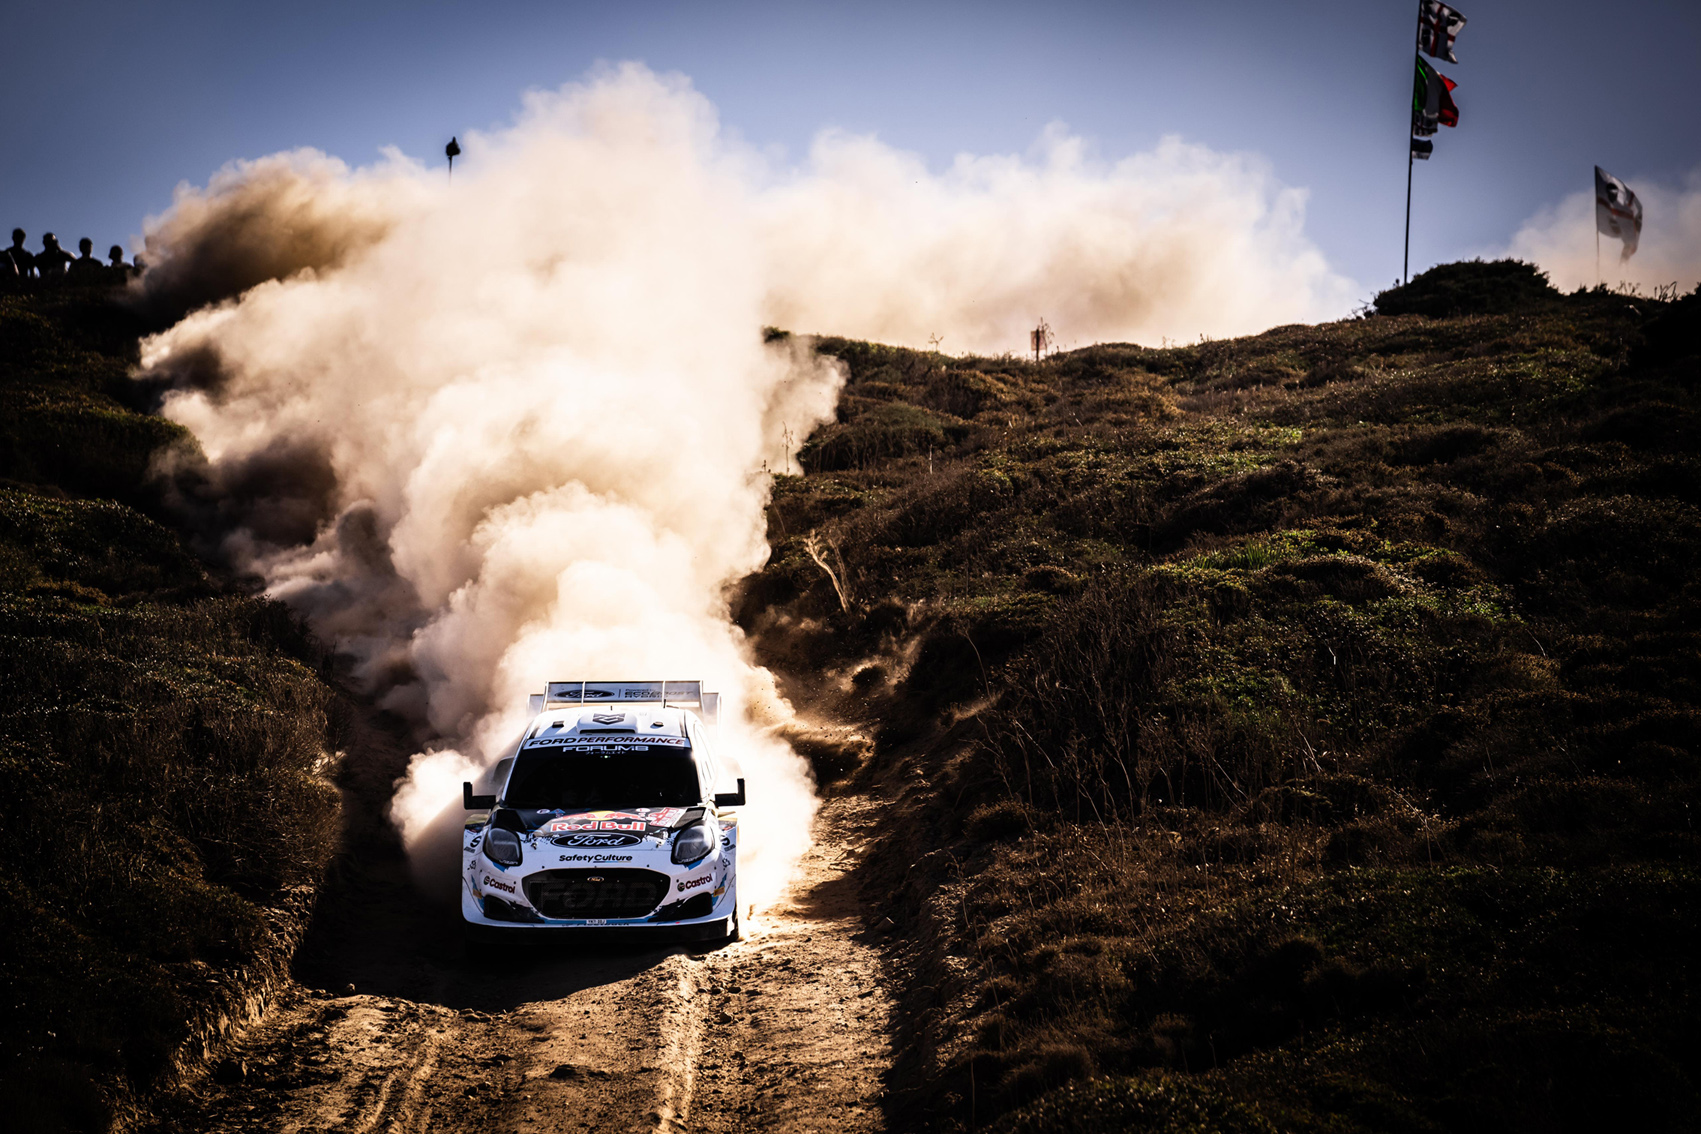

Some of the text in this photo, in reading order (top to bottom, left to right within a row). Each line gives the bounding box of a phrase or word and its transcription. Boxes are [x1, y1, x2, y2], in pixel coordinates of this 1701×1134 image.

[529, 736, 685, 747] FORD PERFORMANCE
[551, 821, 645, 832] Red Bull
[567, 833, 624, 847] Ford
[559, 853, 633, 862] SafetyCulture
[489, 878, 516, 894] Castrol
[685, 874, 713, 890] Castrol
